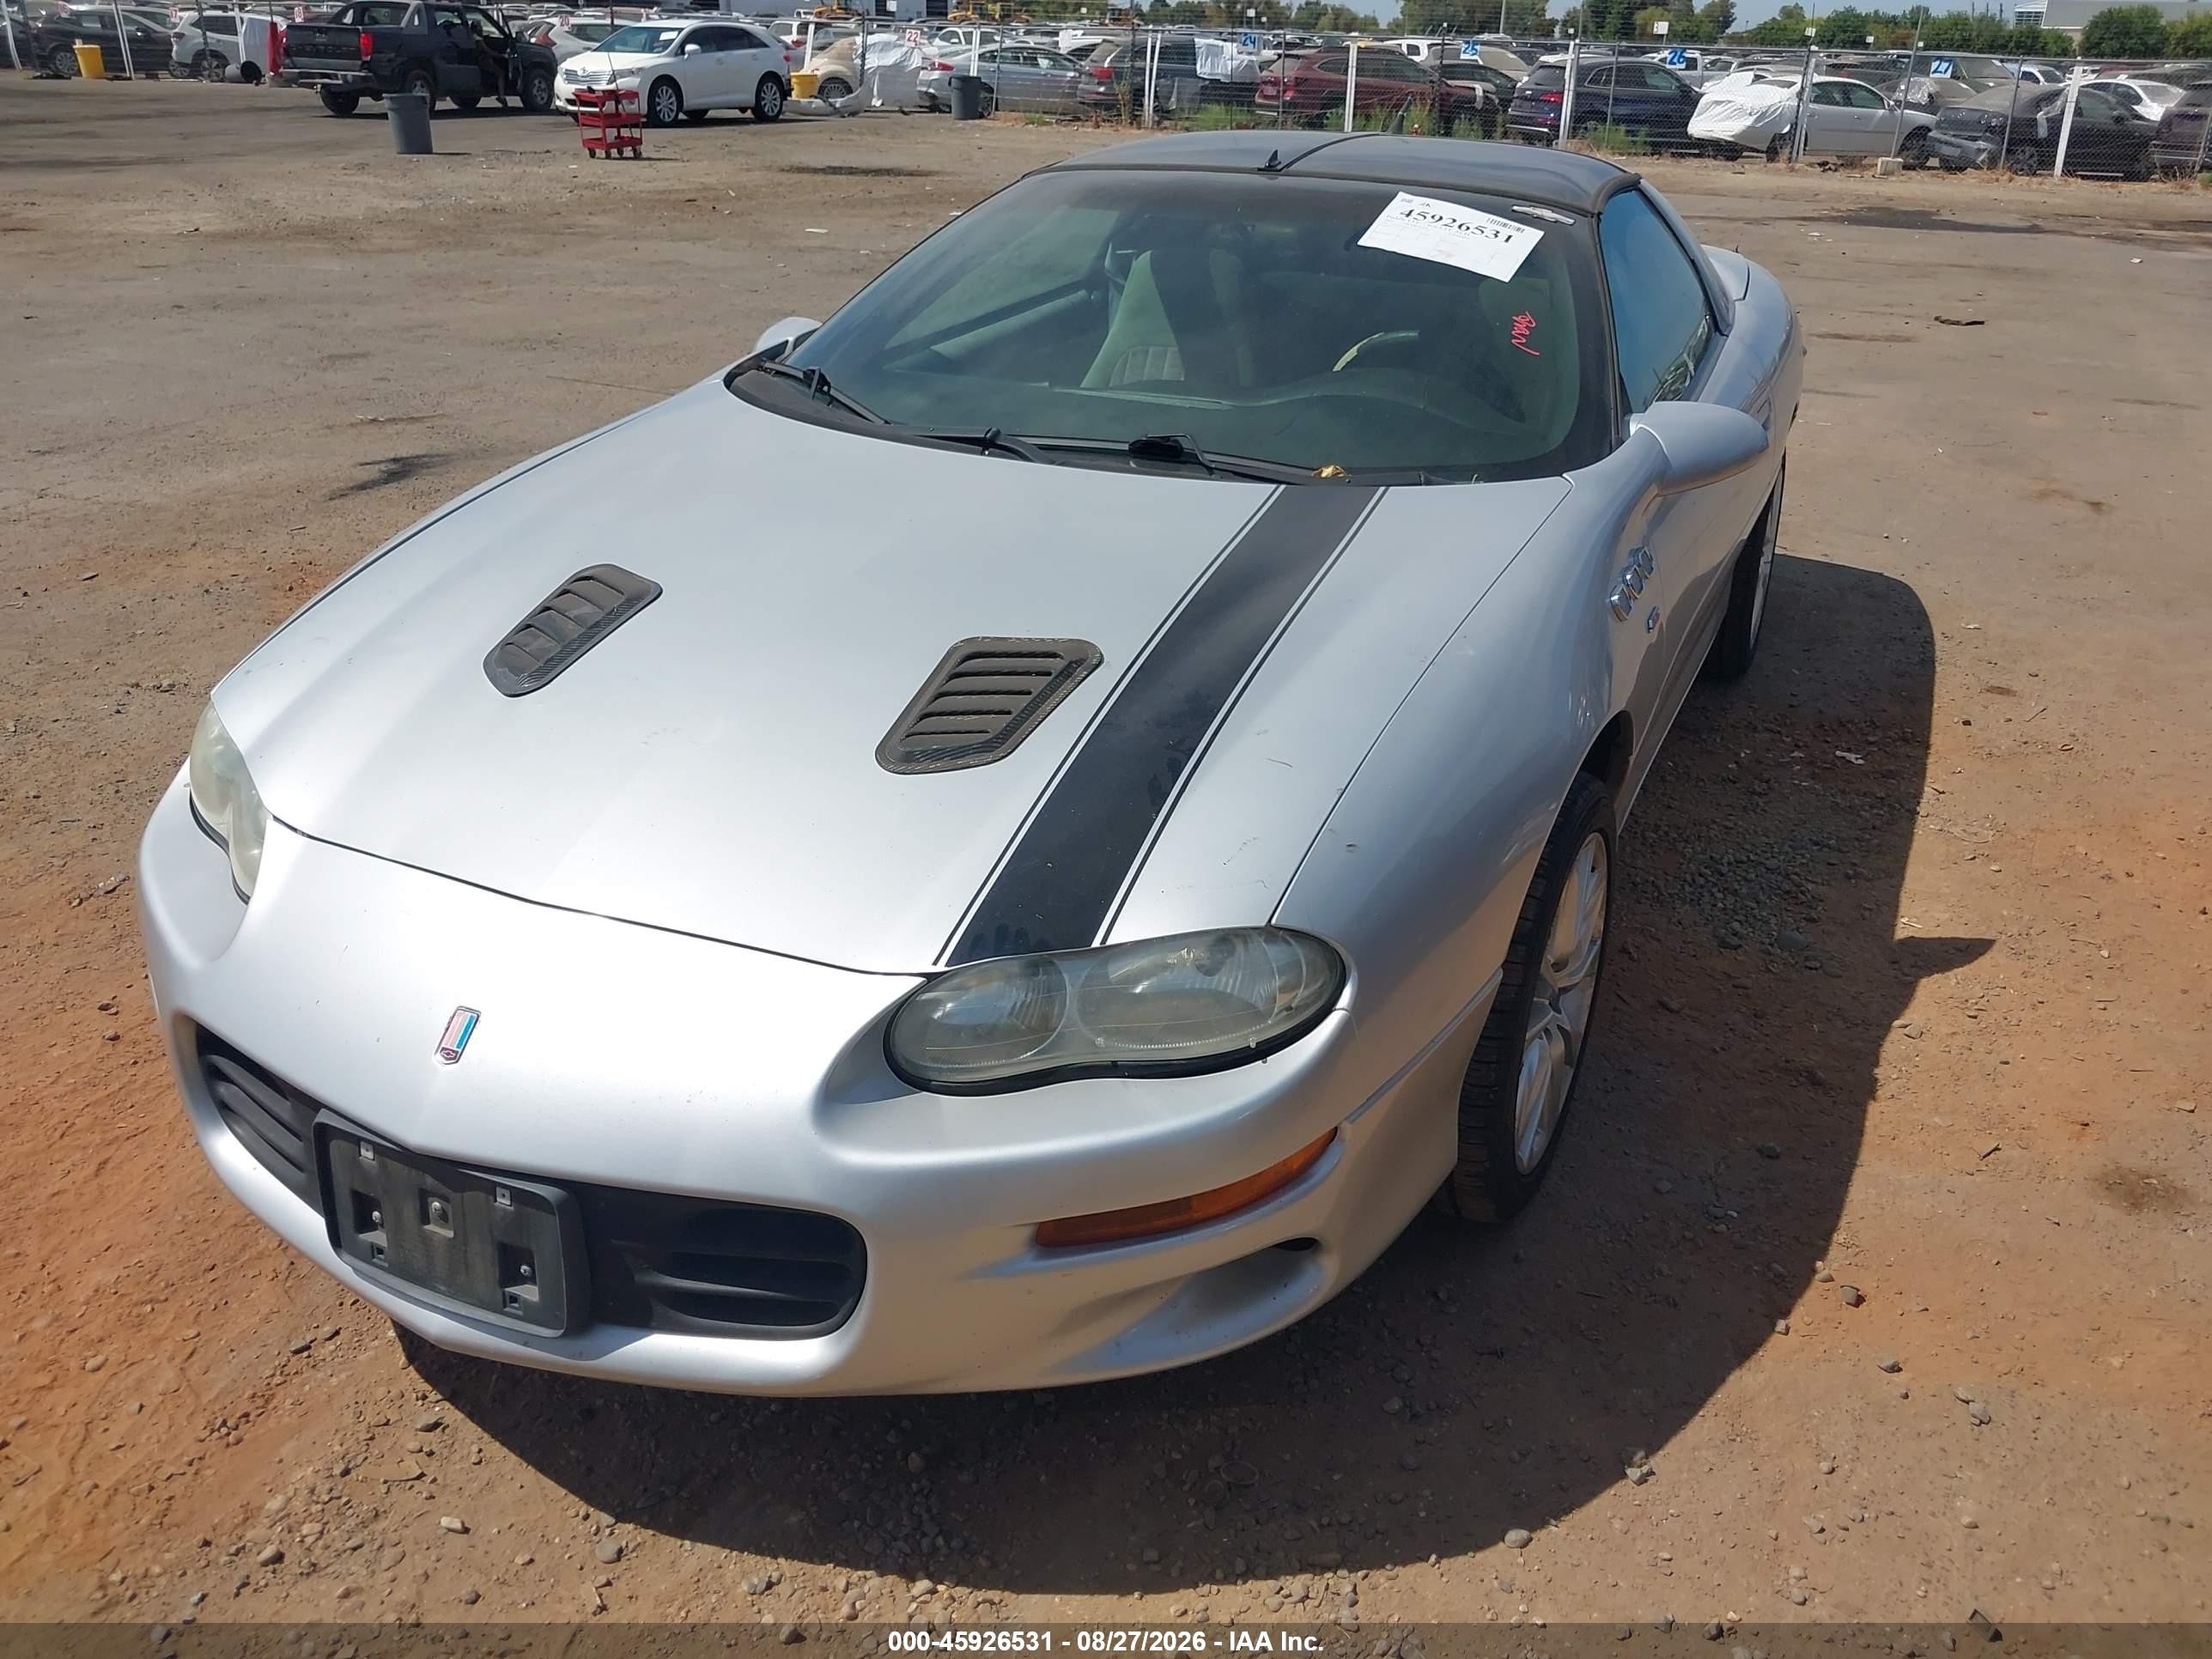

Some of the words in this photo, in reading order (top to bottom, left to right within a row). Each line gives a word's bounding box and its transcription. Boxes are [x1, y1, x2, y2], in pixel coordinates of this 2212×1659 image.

[295, 8, 303, 19] 18
[560, 15, 570, 27] 20
[906, 31, 919, 43] 22
[1242, 33, 1256, 49] 24
[1462, 41, 1479, 56] 25
[1668, 49, 1686, 65] 26
[1932, 58, 1954, 75] 27
[1399, 208, 1514, 244] 45926531
